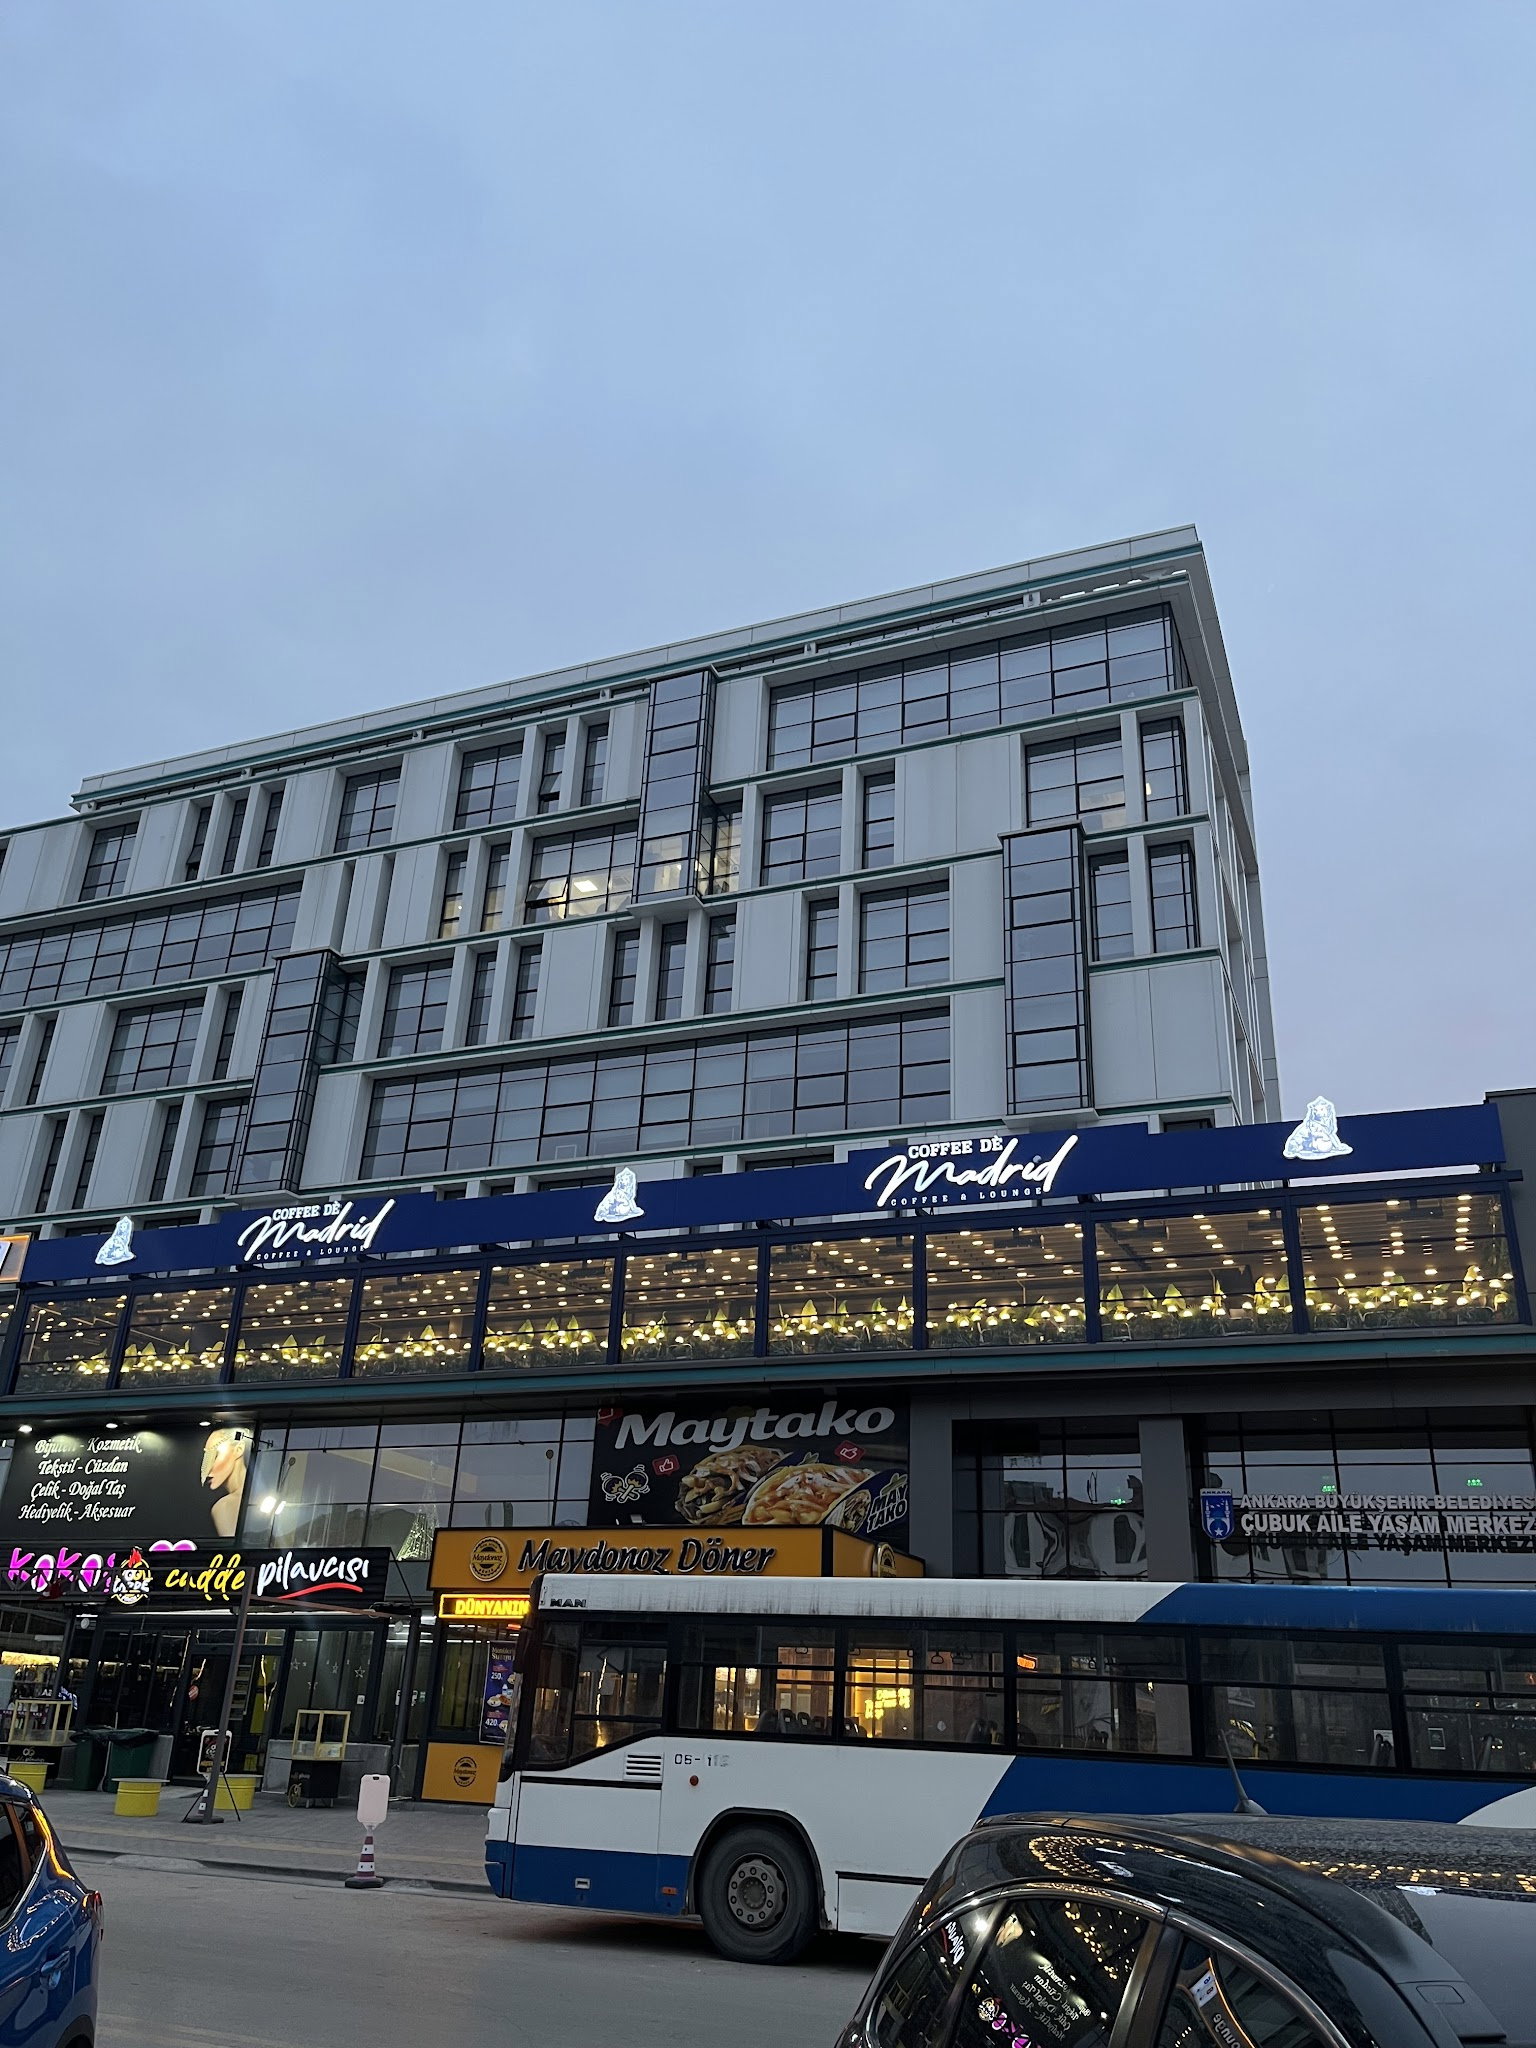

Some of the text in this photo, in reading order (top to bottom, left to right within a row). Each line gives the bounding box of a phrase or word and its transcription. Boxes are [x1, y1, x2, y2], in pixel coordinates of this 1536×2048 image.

[908, 1139, 972, 1159] COFFEE
[864, 1134, 1079, 1207] Madrid
[890, 1194, 948, 1206] COFFEE
[979, 1187, 1043, 1199] LOUNGE
[272, 1204, 320, 1221] COFFEE
[237, 1198, 396, 1262] Madrid
[256, 1250, 299, 1260] COFFEE
[320, 1245, 366, 1255] LOUNGE
[614, 1400, 895, 1453] Maytako
[86, 1435, 143, 1453] Kozmetik
[38, 1457, 80, 1477] Tekstil
[84, 1456, 128, 1474] Cüzdan
[68, 1479, 108, 1500] Doğal
[105, 1479, 127, 1499] Taş
[870, 1485, 908, 1515] MAY
[78, 1501, 136, 1522] Aksesuar
[1240, 1495, 1311, 1509] ANKARA
[1317, 1491, 1434, 1513] BÜYÜKŞEHİR
[867, 1499, 908, 1533] TAKO
[1241, 1514, 1312, 1536] ÇUBUK
[1317, 1510, 1363, 1533] AİLE
[1368, 1515, 1440, 1538] YAŞAM
[473, 1553, 503, 1563] Maydonoz
[518, 1536, 776, 1572] Maydonoz Döner
[165, 1551, 370, 1601] cadde pilavcısı
[454, 1597, 531, 1616] DÜNYANIN
[550, 1598, 587, 1608] MAN
